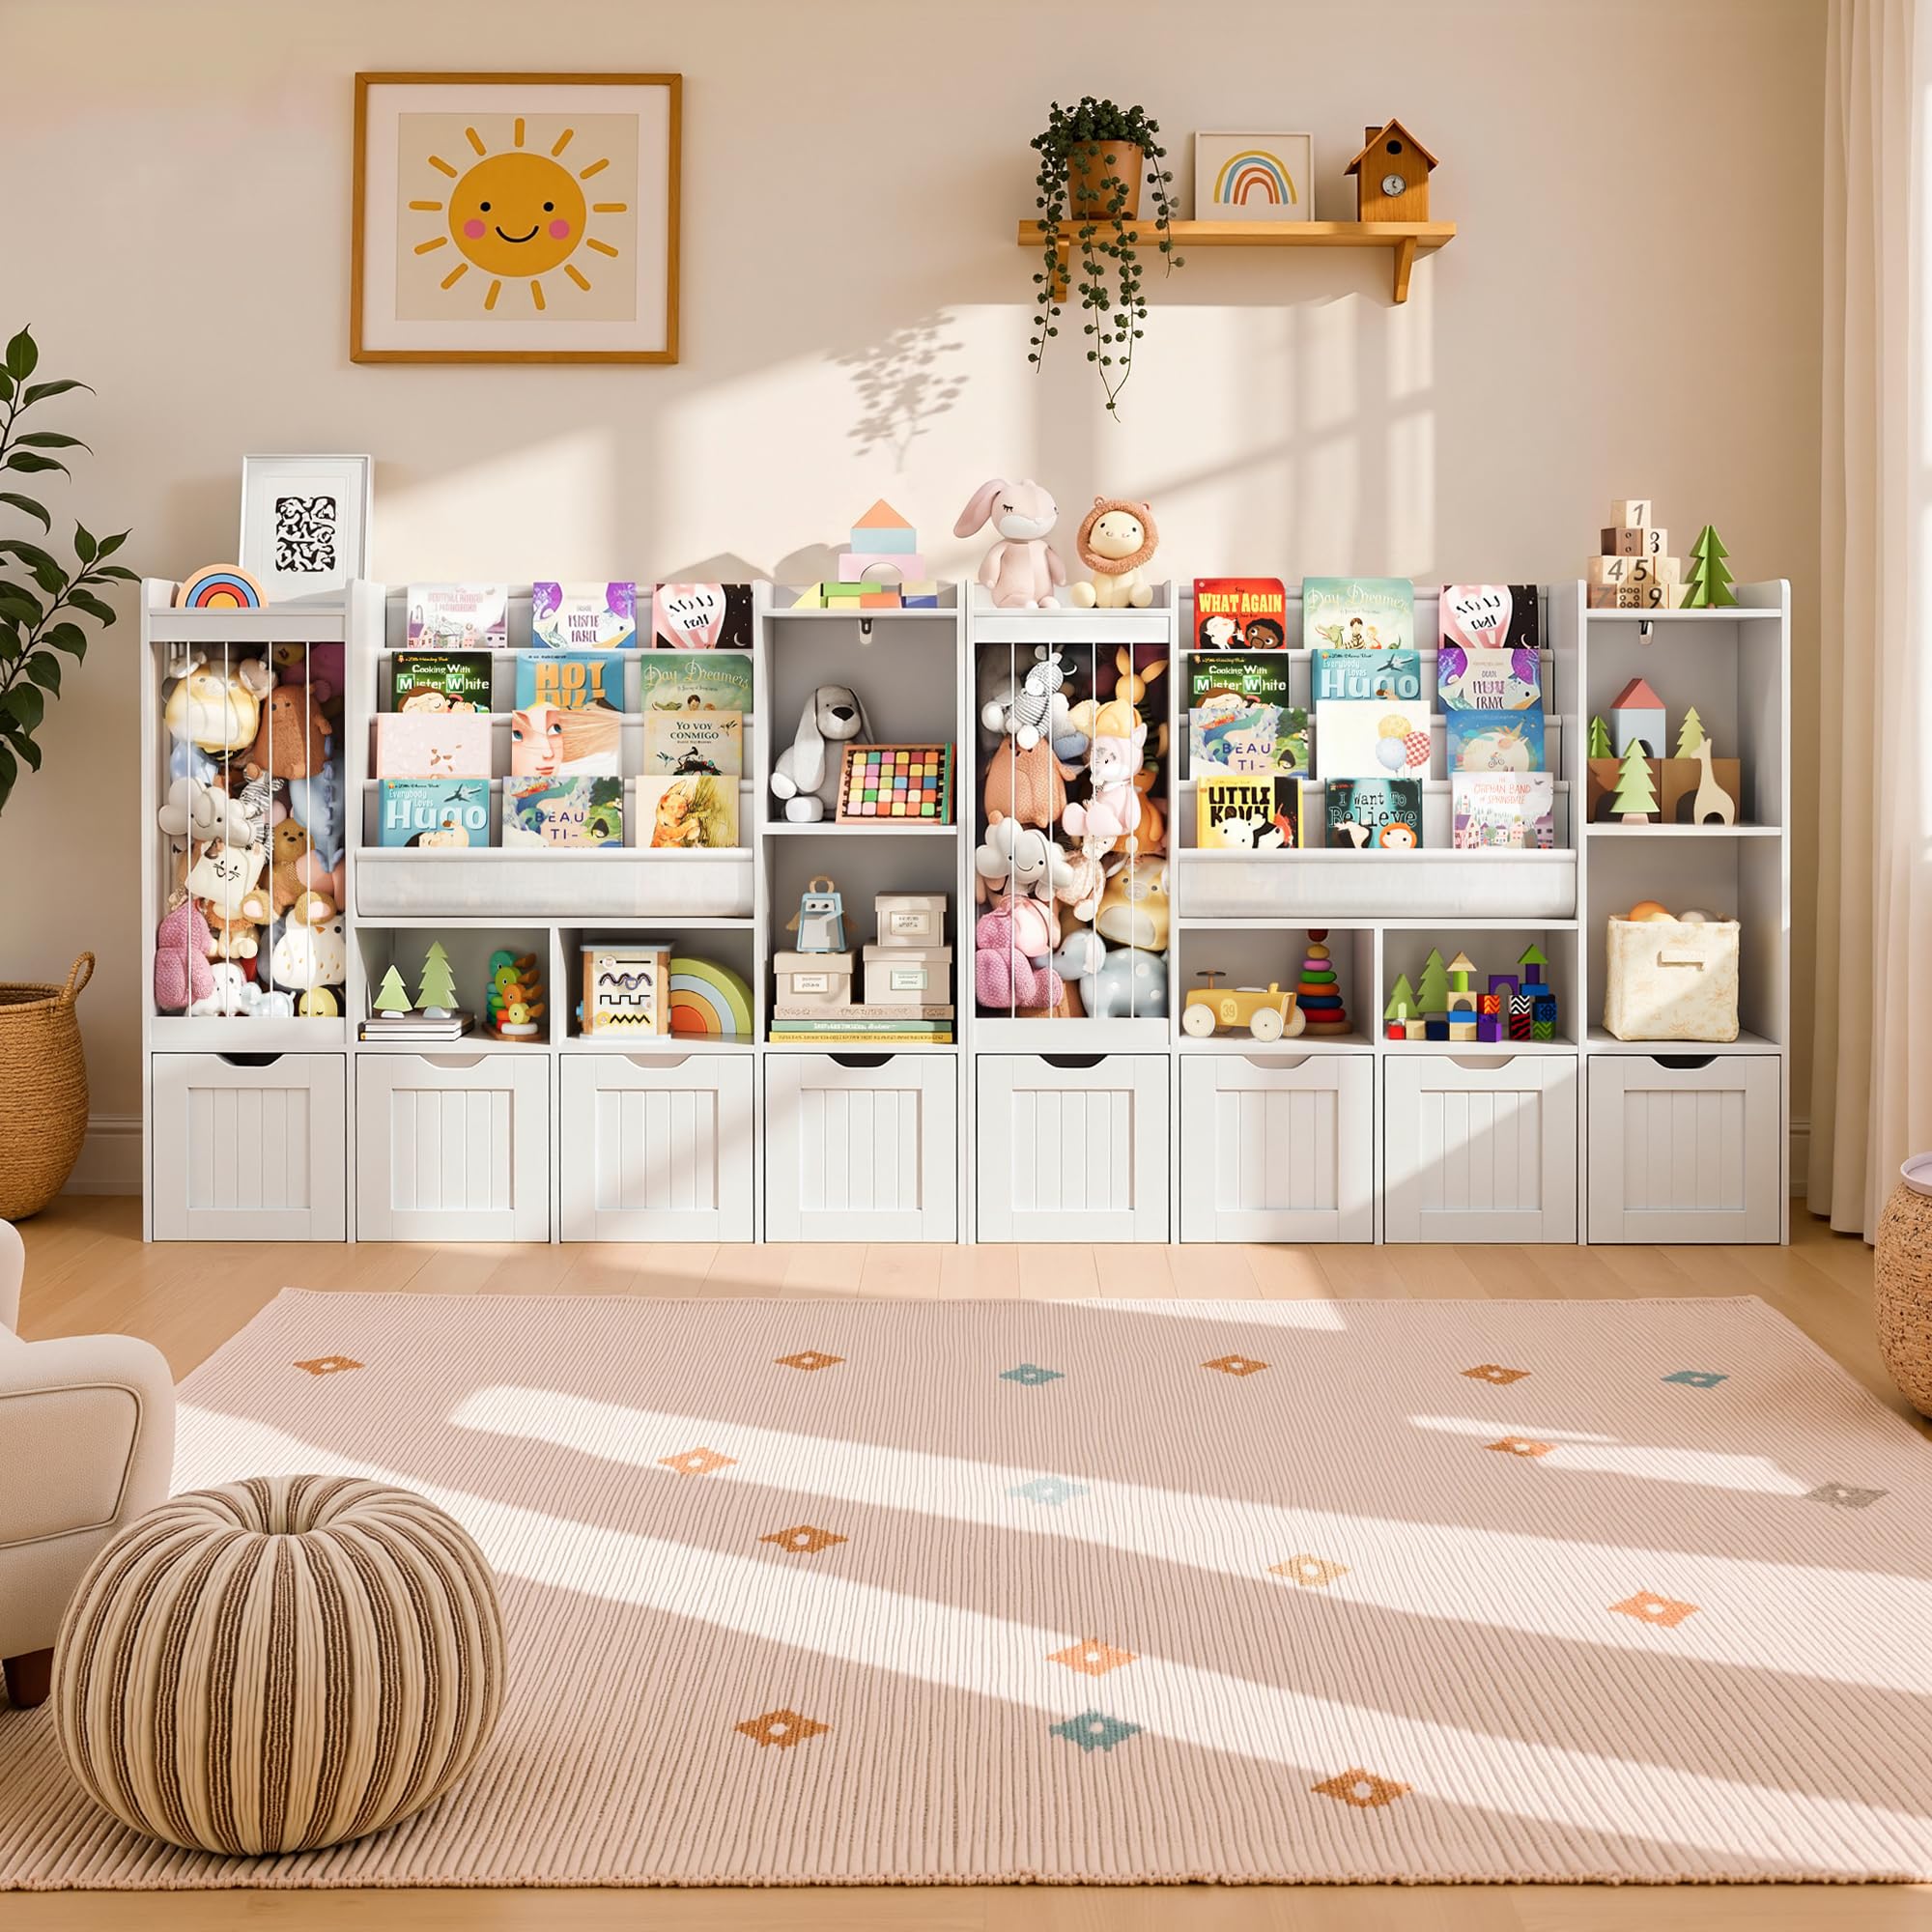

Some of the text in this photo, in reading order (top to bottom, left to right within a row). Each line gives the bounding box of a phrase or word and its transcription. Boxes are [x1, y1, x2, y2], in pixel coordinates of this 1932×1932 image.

[1633, 503, 1644, 526] 1
[1650, 531, 1660, 554] 3
[1607, 558, 1648, 581] 4 5
[1199, 593, 1282, 612] WHAT AGAIN
[1649, 587, 1662, 609] 9
[412, 665, 446, 674] Cooking
[1208, 666, 1267, 675] Cooking With
[1322, 660, 1360, 669] Everybody
[536, 662, 606, 690] HOT
[643, 658, 749, 689] Day Dreamers
[399, 678, 490, 690] Mister White
[1197, 679, 1241, 691] Mister
[1237, 760, 1265, 770] TI-
[389, 790, 427, 800] Everybody
[1339, 792, 1347, 806] I
[1354, 792, 1384, 806] Want
[1328, 806, 1417, 828] Believe
[551, 829, 578, 839] TI-
[1223, 1005, 1236, 1017] 39
